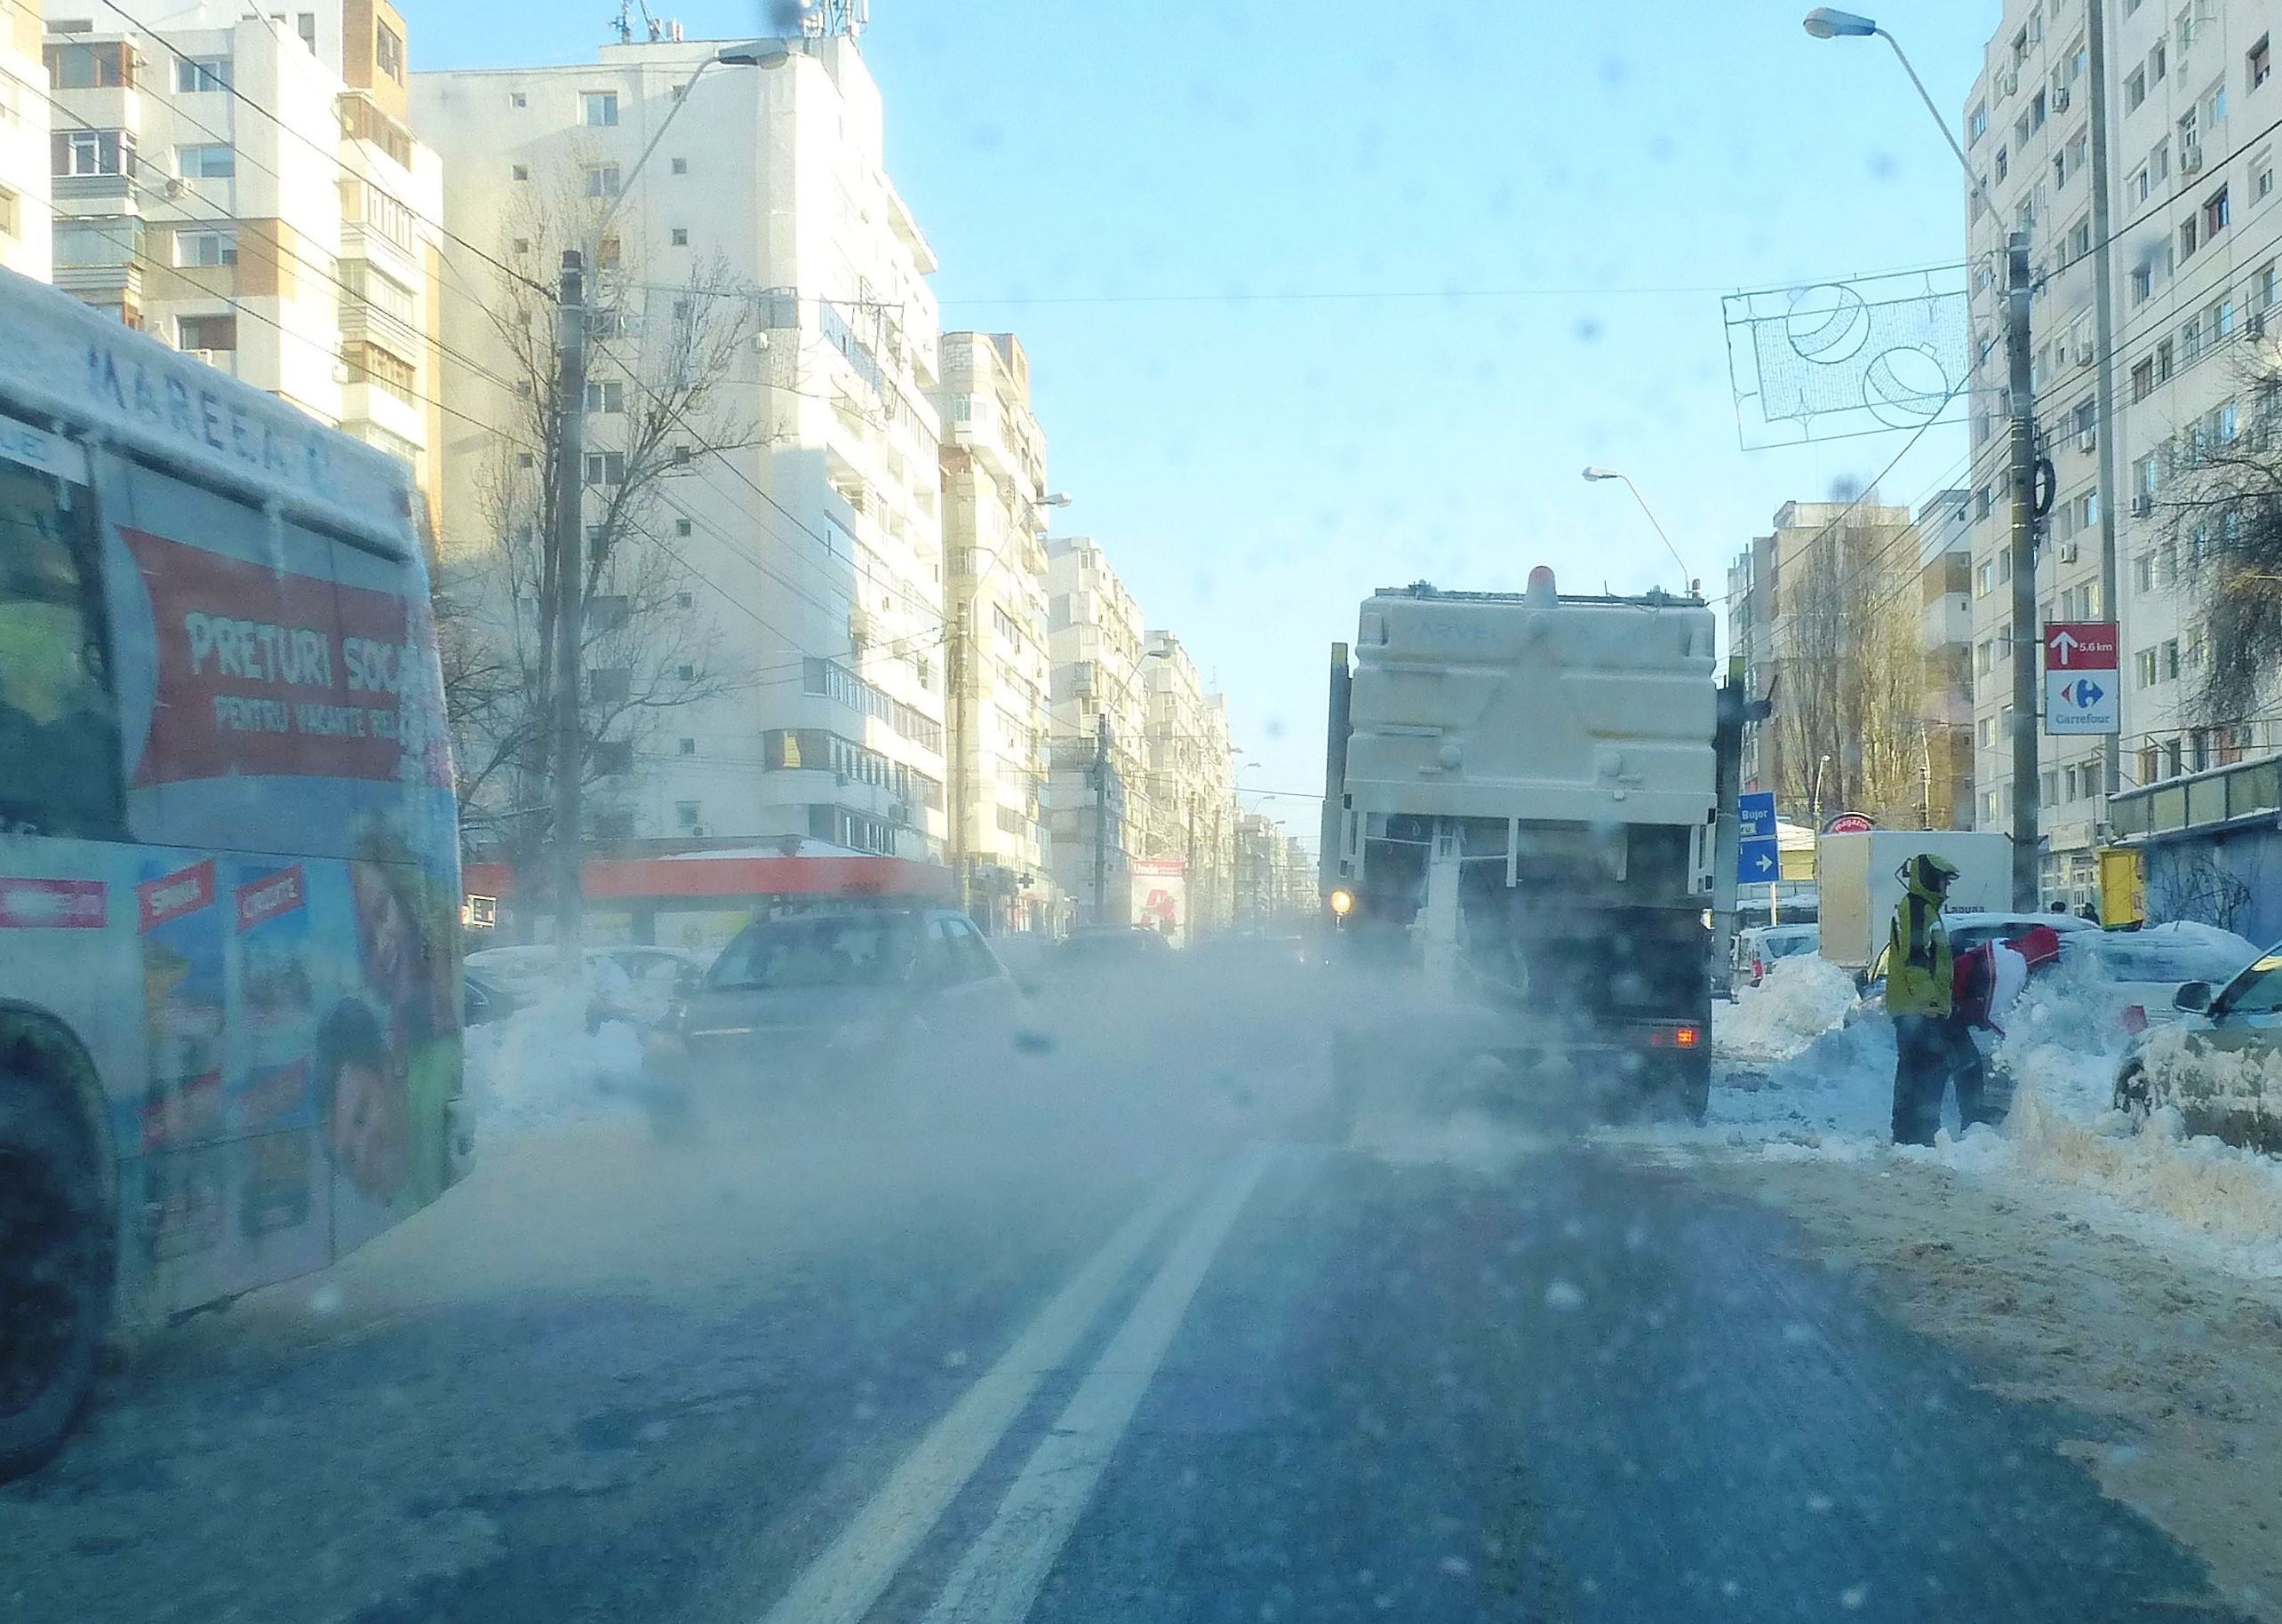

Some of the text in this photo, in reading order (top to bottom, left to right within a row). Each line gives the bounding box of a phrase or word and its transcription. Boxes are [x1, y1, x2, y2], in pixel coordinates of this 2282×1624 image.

[2096, 642, 2113, 651] km
[2055, 713, 2111, 725] Carrefour
[1742, 809, 1768, 821] Bujor
[1835, 818, 1868, 832] magazin
